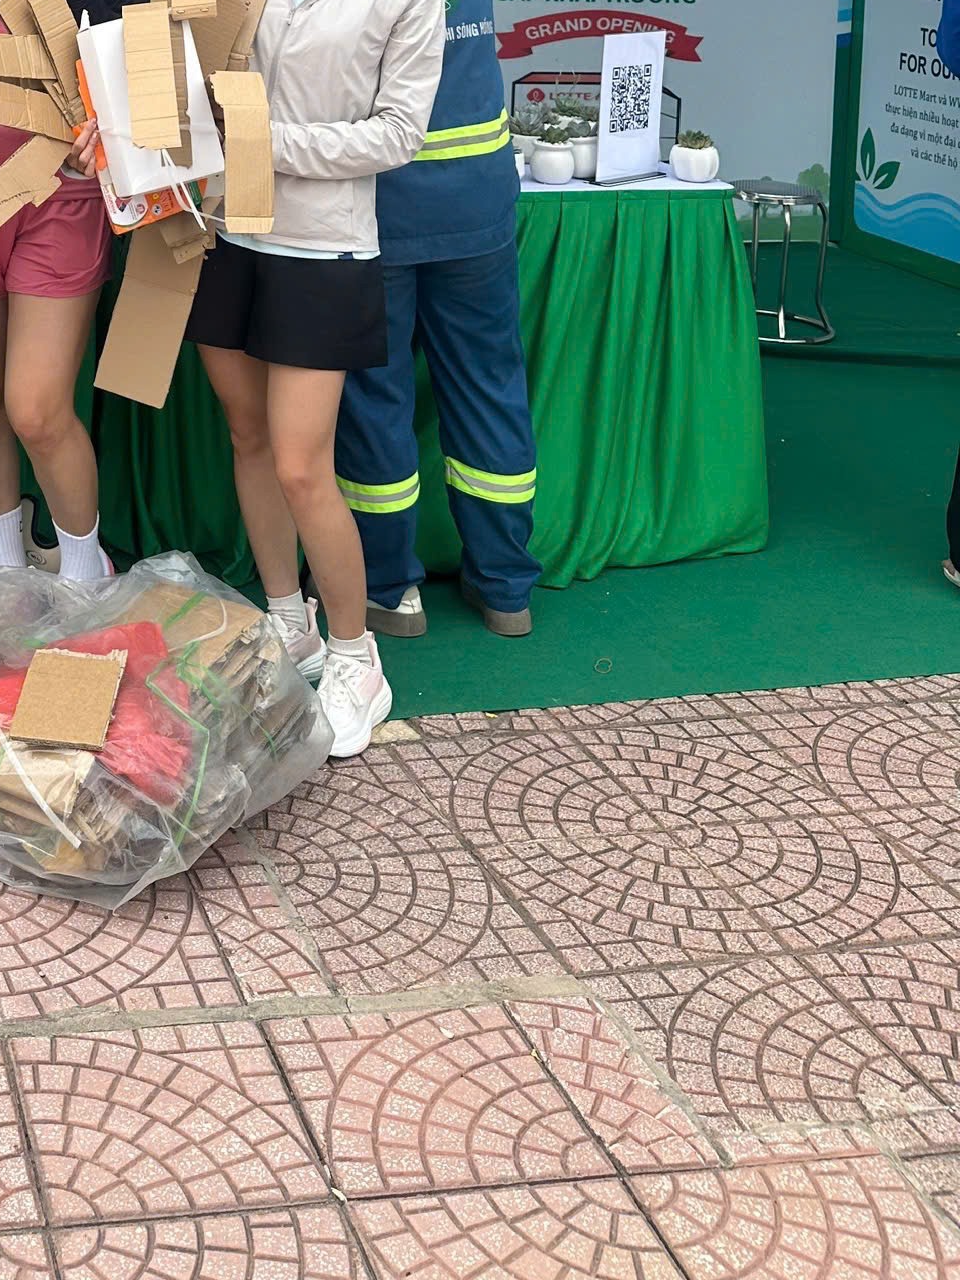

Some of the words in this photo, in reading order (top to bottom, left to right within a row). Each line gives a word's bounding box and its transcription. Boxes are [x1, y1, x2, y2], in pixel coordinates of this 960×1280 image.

[456, 22, 479, 40] SÔNG
[525, 18, 592, 41] GRAND
[900, 53, 926, 75] FOR
